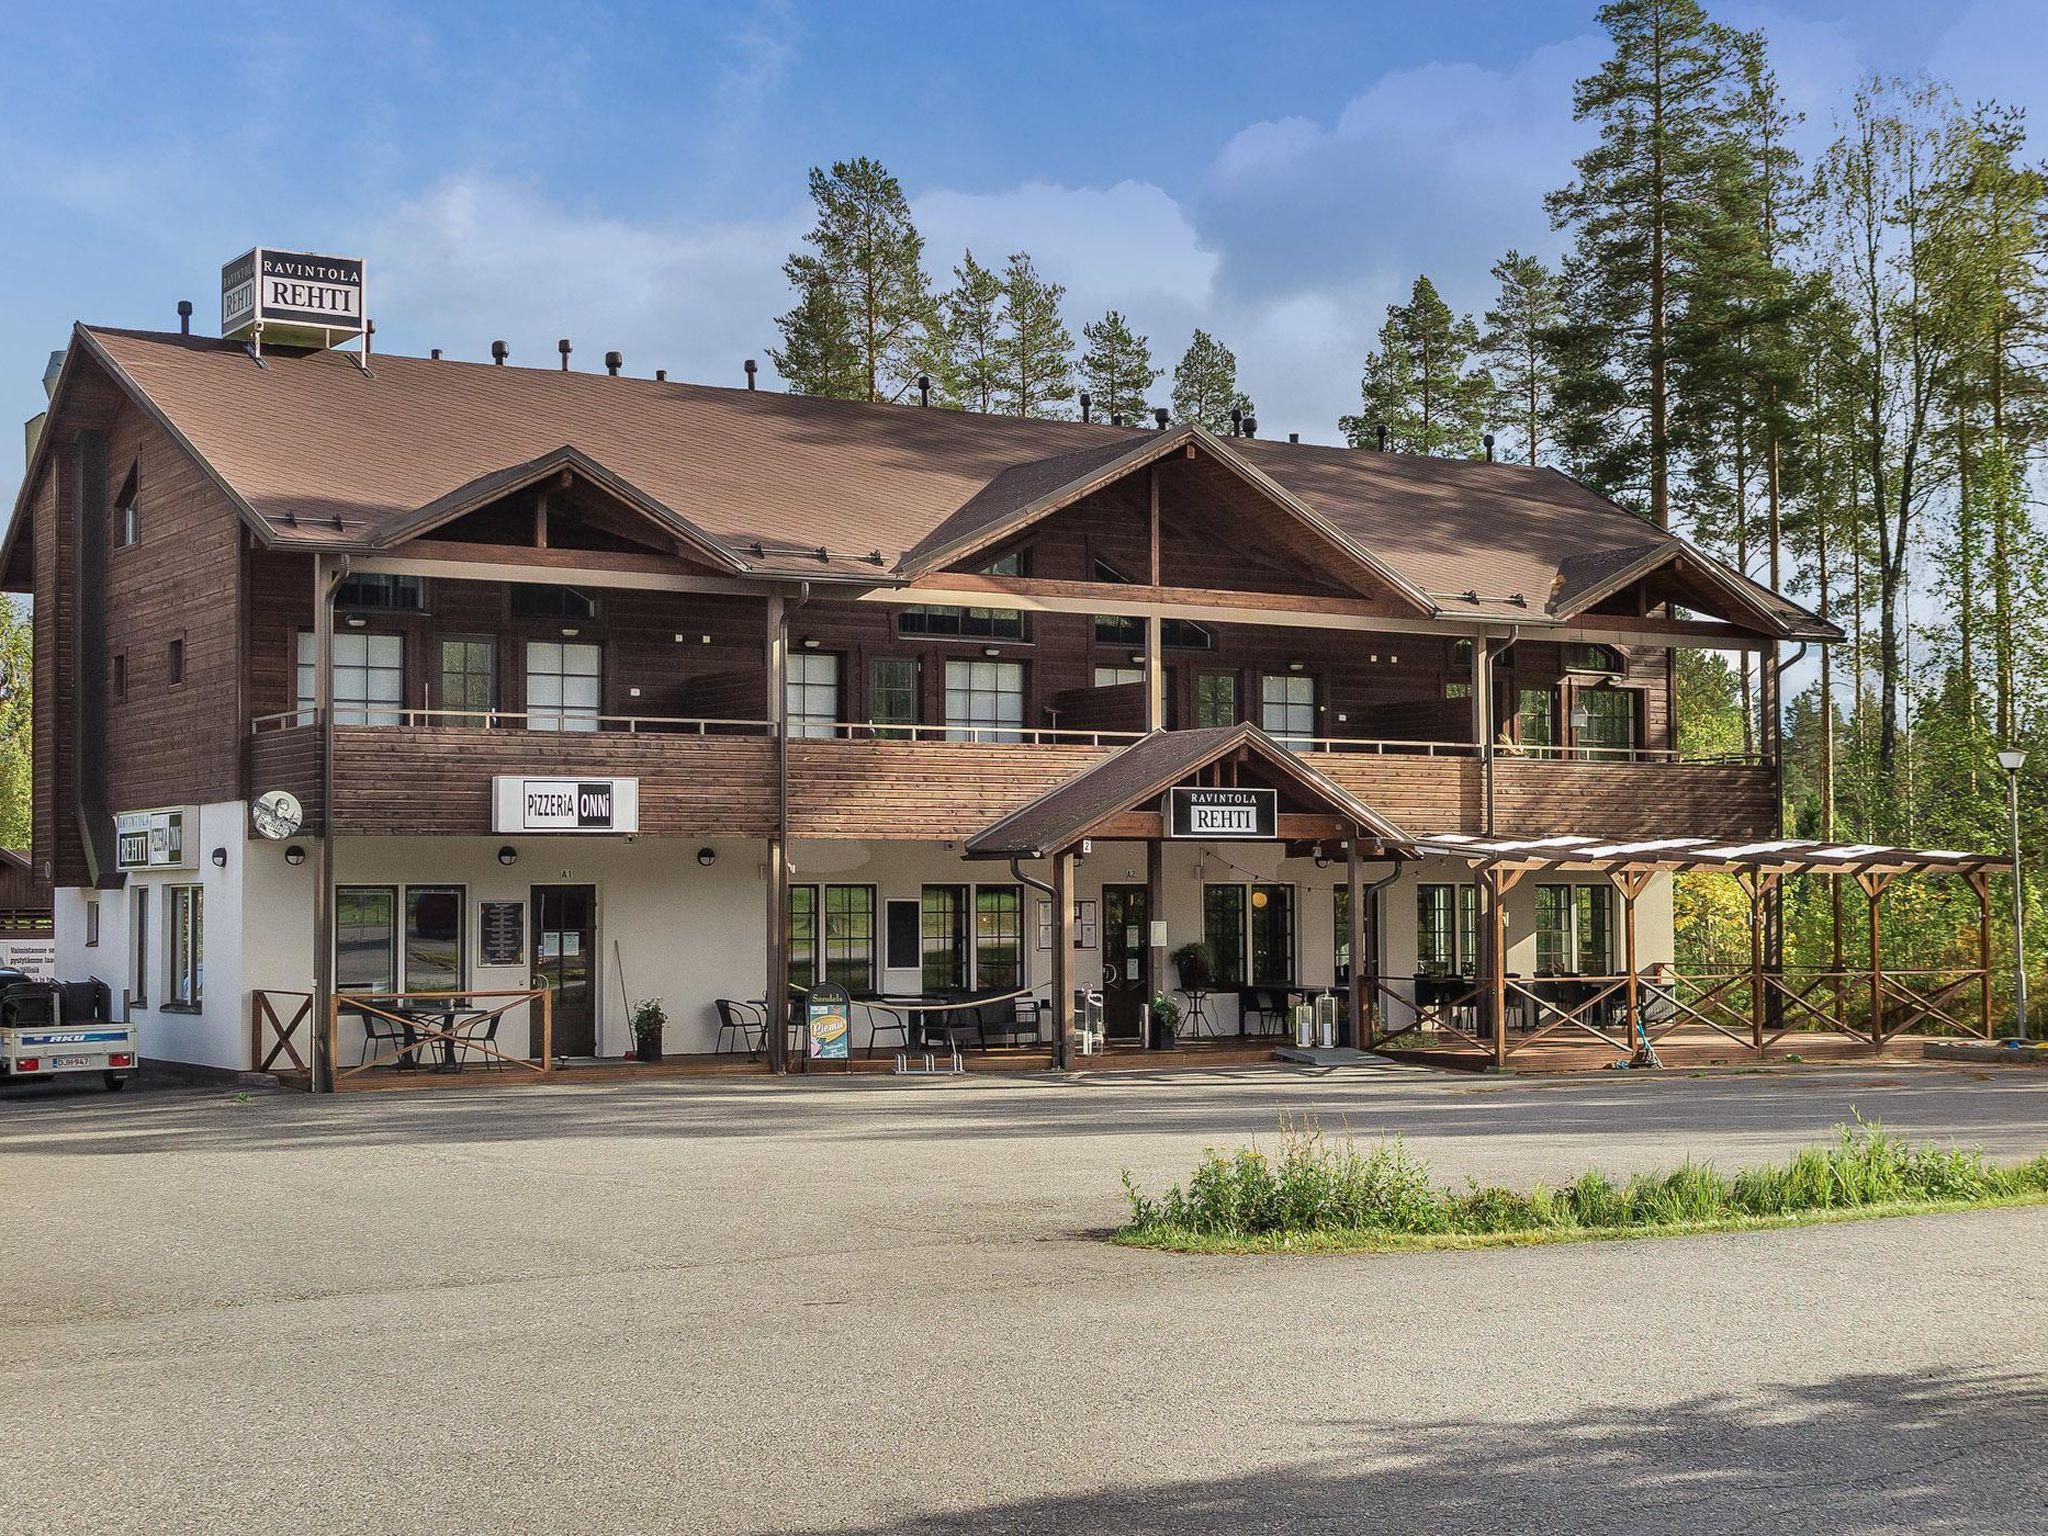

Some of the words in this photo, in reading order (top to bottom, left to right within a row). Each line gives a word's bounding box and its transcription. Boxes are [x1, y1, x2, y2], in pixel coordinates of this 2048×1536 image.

[263, 260, 360, 282] RAVINTOLA
[226, 283, 252, 318] REHTI
[271, 281, 351, 312] REHTI
[1191, 793, 1257, 803] RAVINTOLA
[1197, 810, 1250, 828] REHTI
[120, 836, 146, 862] REHTI
[1084, 842, 1090, 851] 2
[812, 993, 843, 1003] Sandels
